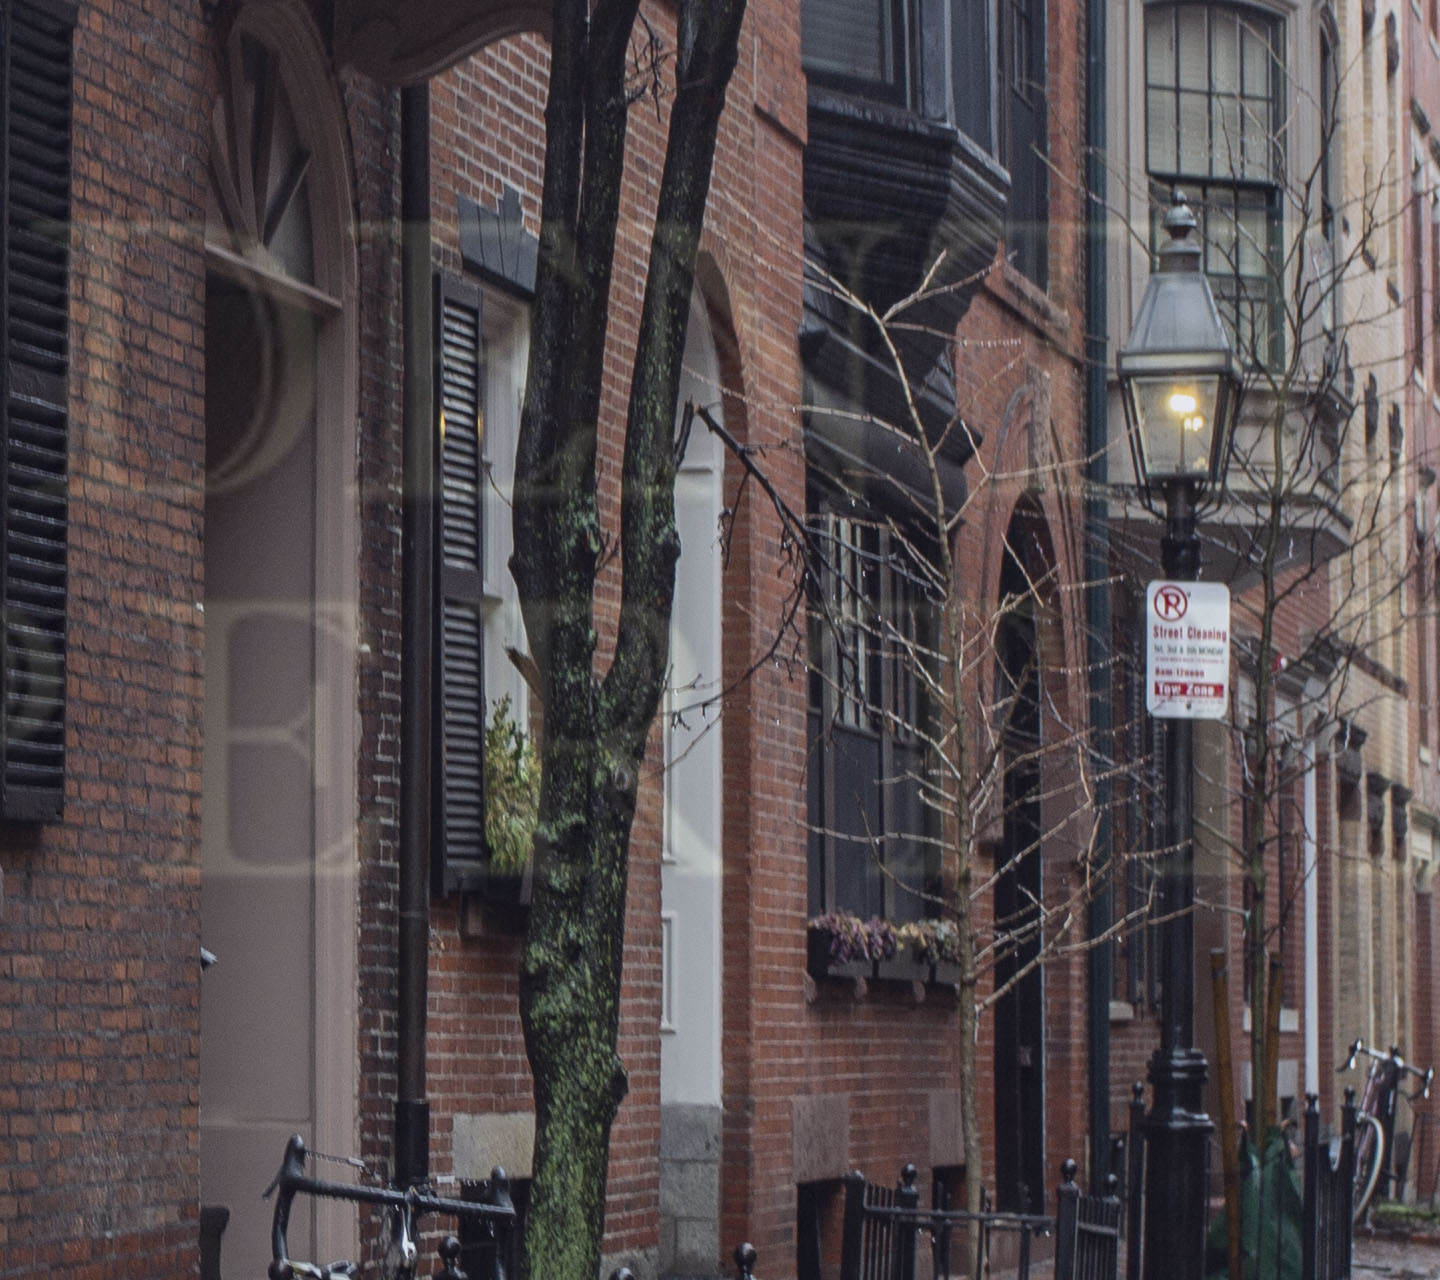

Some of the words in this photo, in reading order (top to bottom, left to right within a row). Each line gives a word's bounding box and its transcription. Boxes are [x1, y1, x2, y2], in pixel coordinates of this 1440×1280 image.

[1153, 625, 1183, 639] Street
[1187, 625, 1227, 643] Cleaning
[1158, 682, 1181, 697] Tow
[1186, 682, 1215, 698] Zone
